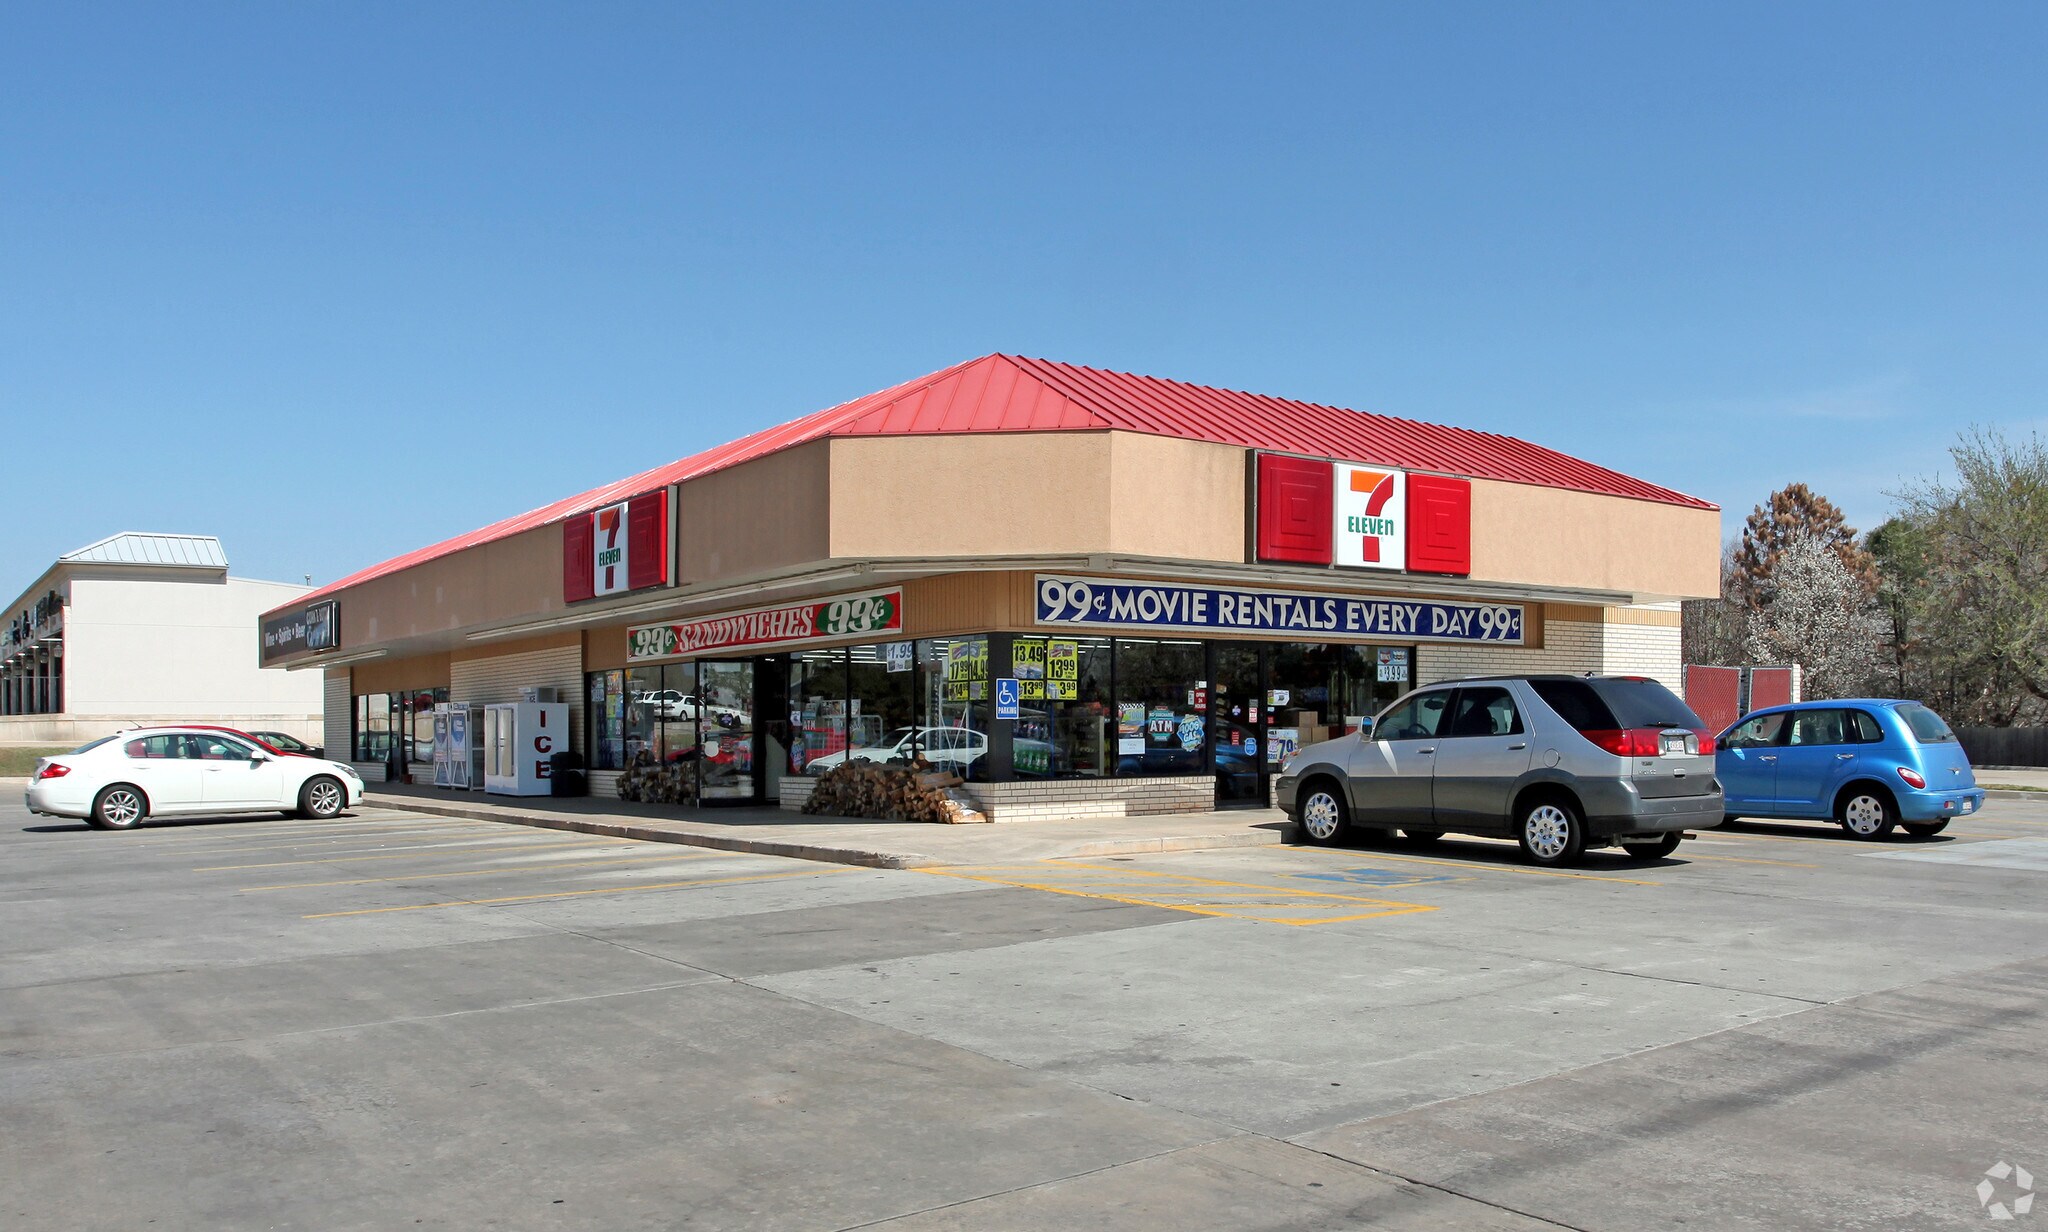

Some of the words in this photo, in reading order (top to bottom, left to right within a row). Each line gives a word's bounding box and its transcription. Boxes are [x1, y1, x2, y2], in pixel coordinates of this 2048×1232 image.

[1351, 470, 1394, 562] 7
[600, 508, 620, 590] 7
[679, 605, 814, 652] SANDWICHES
[1108, 588, 1207, 623] MOVIE
[1219, 594, 1337, 630] RENTALS
[1346, 601, 1422, 633] EVERY
[1432, 607, 1475, 636] DAY
[265, 632, 275, 648] Wine
[1014, 645, 1043, 662] 13.49
[534, 710, 552, 779] ICE
[803, 720, 816, 730] ATM
[1150, 720, 1173, 732] ATM
